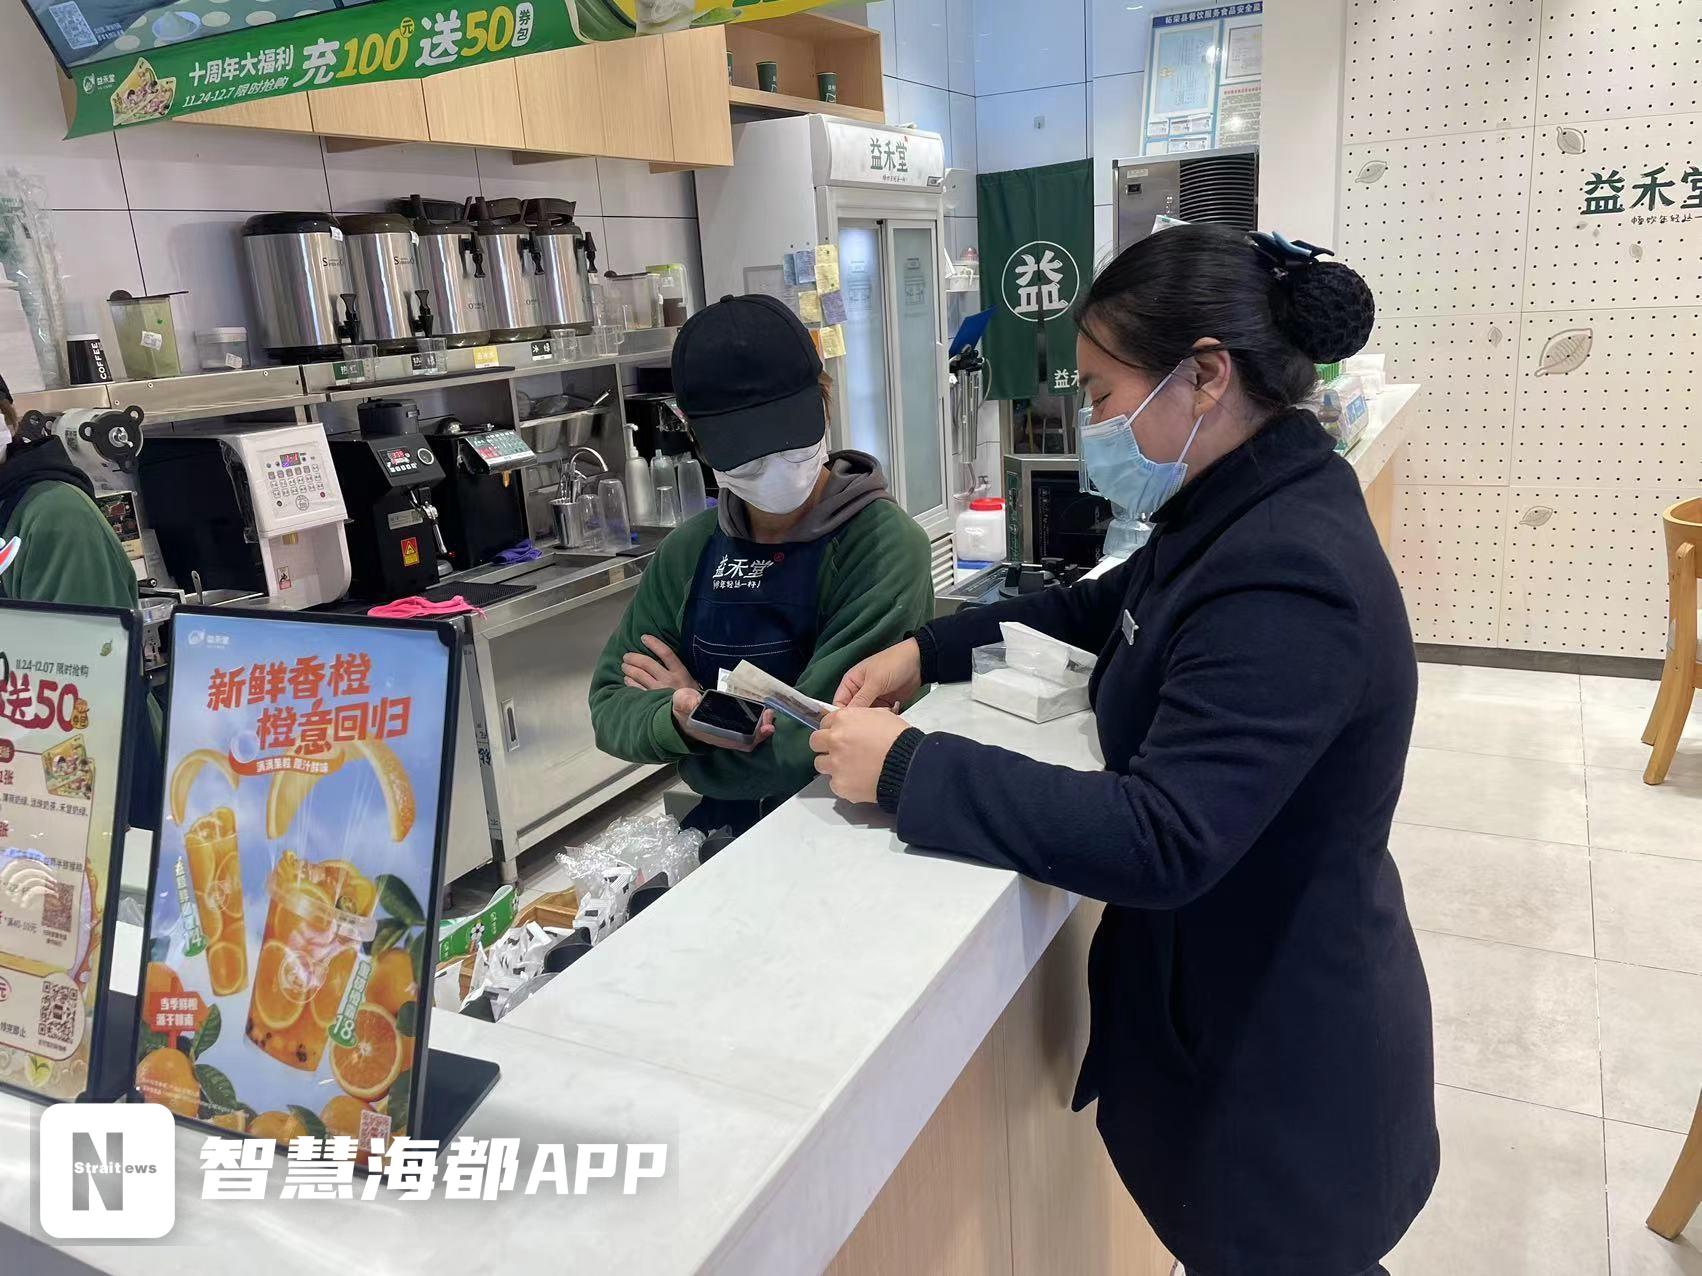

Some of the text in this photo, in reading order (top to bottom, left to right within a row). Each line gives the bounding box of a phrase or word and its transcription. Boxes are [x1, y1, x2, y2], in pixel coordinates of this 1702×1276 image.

[189, 44, 294, 87] 十周年大福利
[234, 76, 290, 98] 限时抢购
[869, 136, 909, 173] 益禾堂
[1014, 249, 1069, 314] 益
[91, 342, 108, 380] COFFEE
[206, 652, 372, 712] 新鲜香橙
[255, 696, 412, 756] 橙意回归
[333, 1014, 355, 1040] 18
